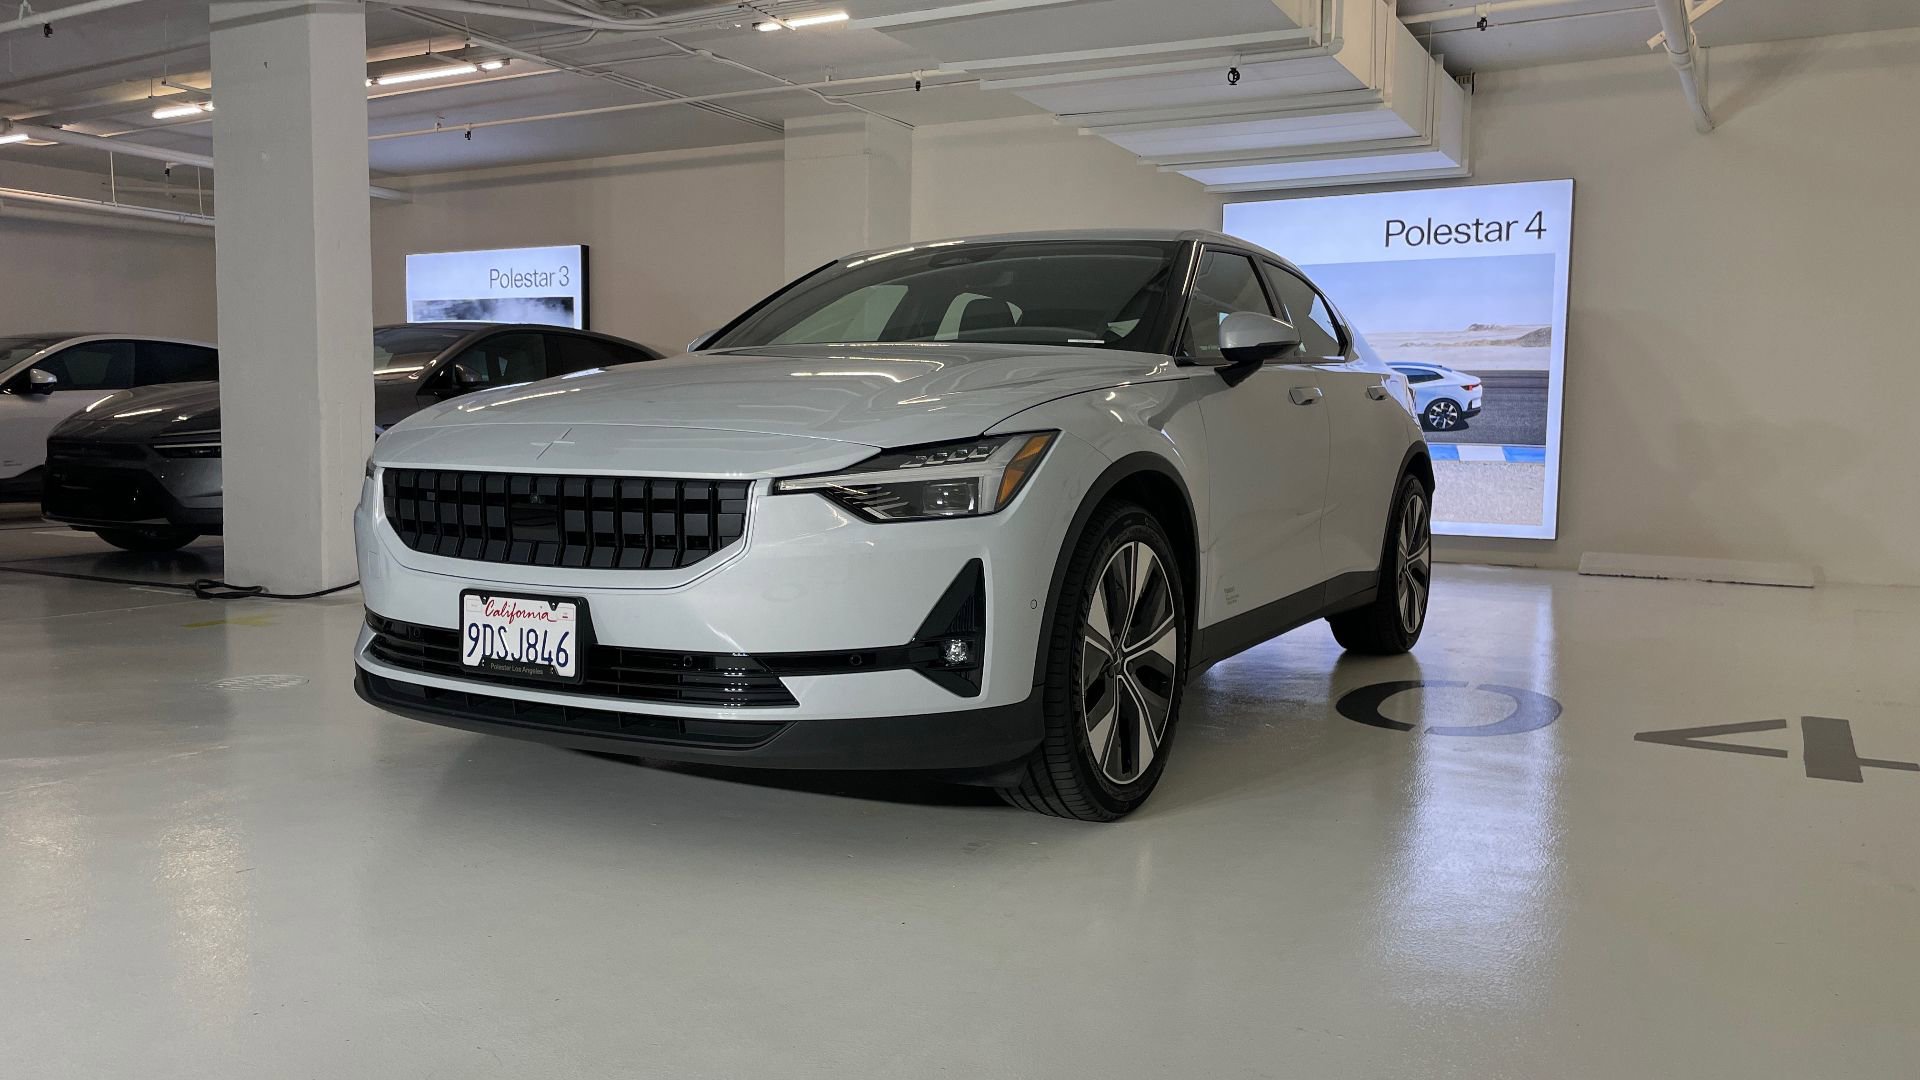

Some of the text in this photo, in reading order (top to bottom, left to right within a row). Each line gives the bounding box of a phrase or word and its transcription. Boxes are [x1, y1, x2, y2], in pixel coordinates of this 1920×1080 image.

[1384, 210, 1547, 248] Polestar 4
[489, 265, 570, 289] Polestar 3
[485, 599, 558, 625] California
[467, 622, 570, 668] 9DSJ846
[490, 662, 544, 676] Polestar Los Angeles
